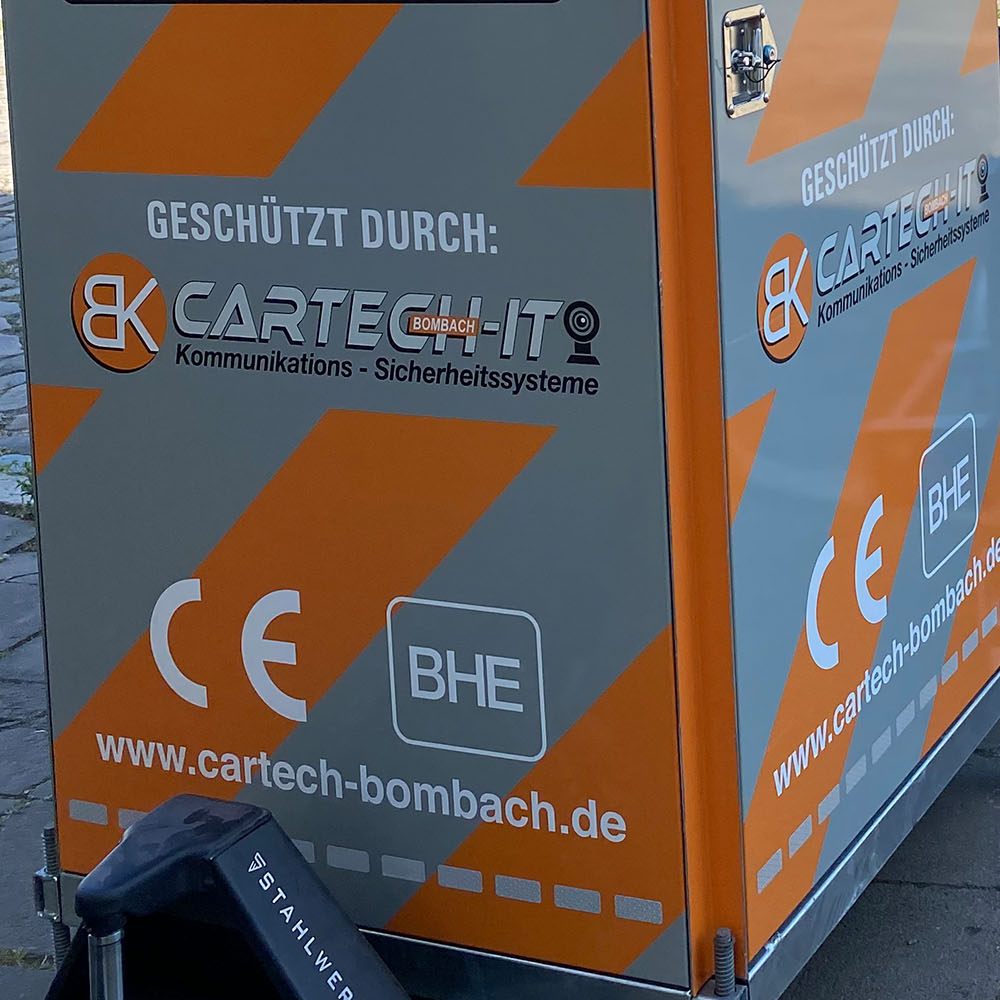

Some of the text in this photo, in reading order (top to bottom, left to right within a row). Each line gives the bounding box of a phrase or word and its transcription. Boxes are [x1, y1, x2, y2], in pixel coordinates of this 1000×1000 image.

[801, 105, 955, 207] GESCHÜTZT DURCH:
[147, 196, 499, 254] GESCHÜTZT DURCH:
[817, 261, 903, 327] Kommunikations
[910, 208, 990, 269] Sicherheitssysteme
[172, 280, 565, 362] CARTECH-IT
[413, 316, 475, 334] BOMBACH
[175, 343, 353, 378] Kommunikations
[374, 358, 600, 396] Sicherheitssysteme
[928, 454, 970, 535] BHE
[805, 494, 888, 669] CE
[150, 578, 307, 722] CE
[408, 645, 524, 713] BHE
[96, 733, 627, 843] www.cartech-bombach.de
